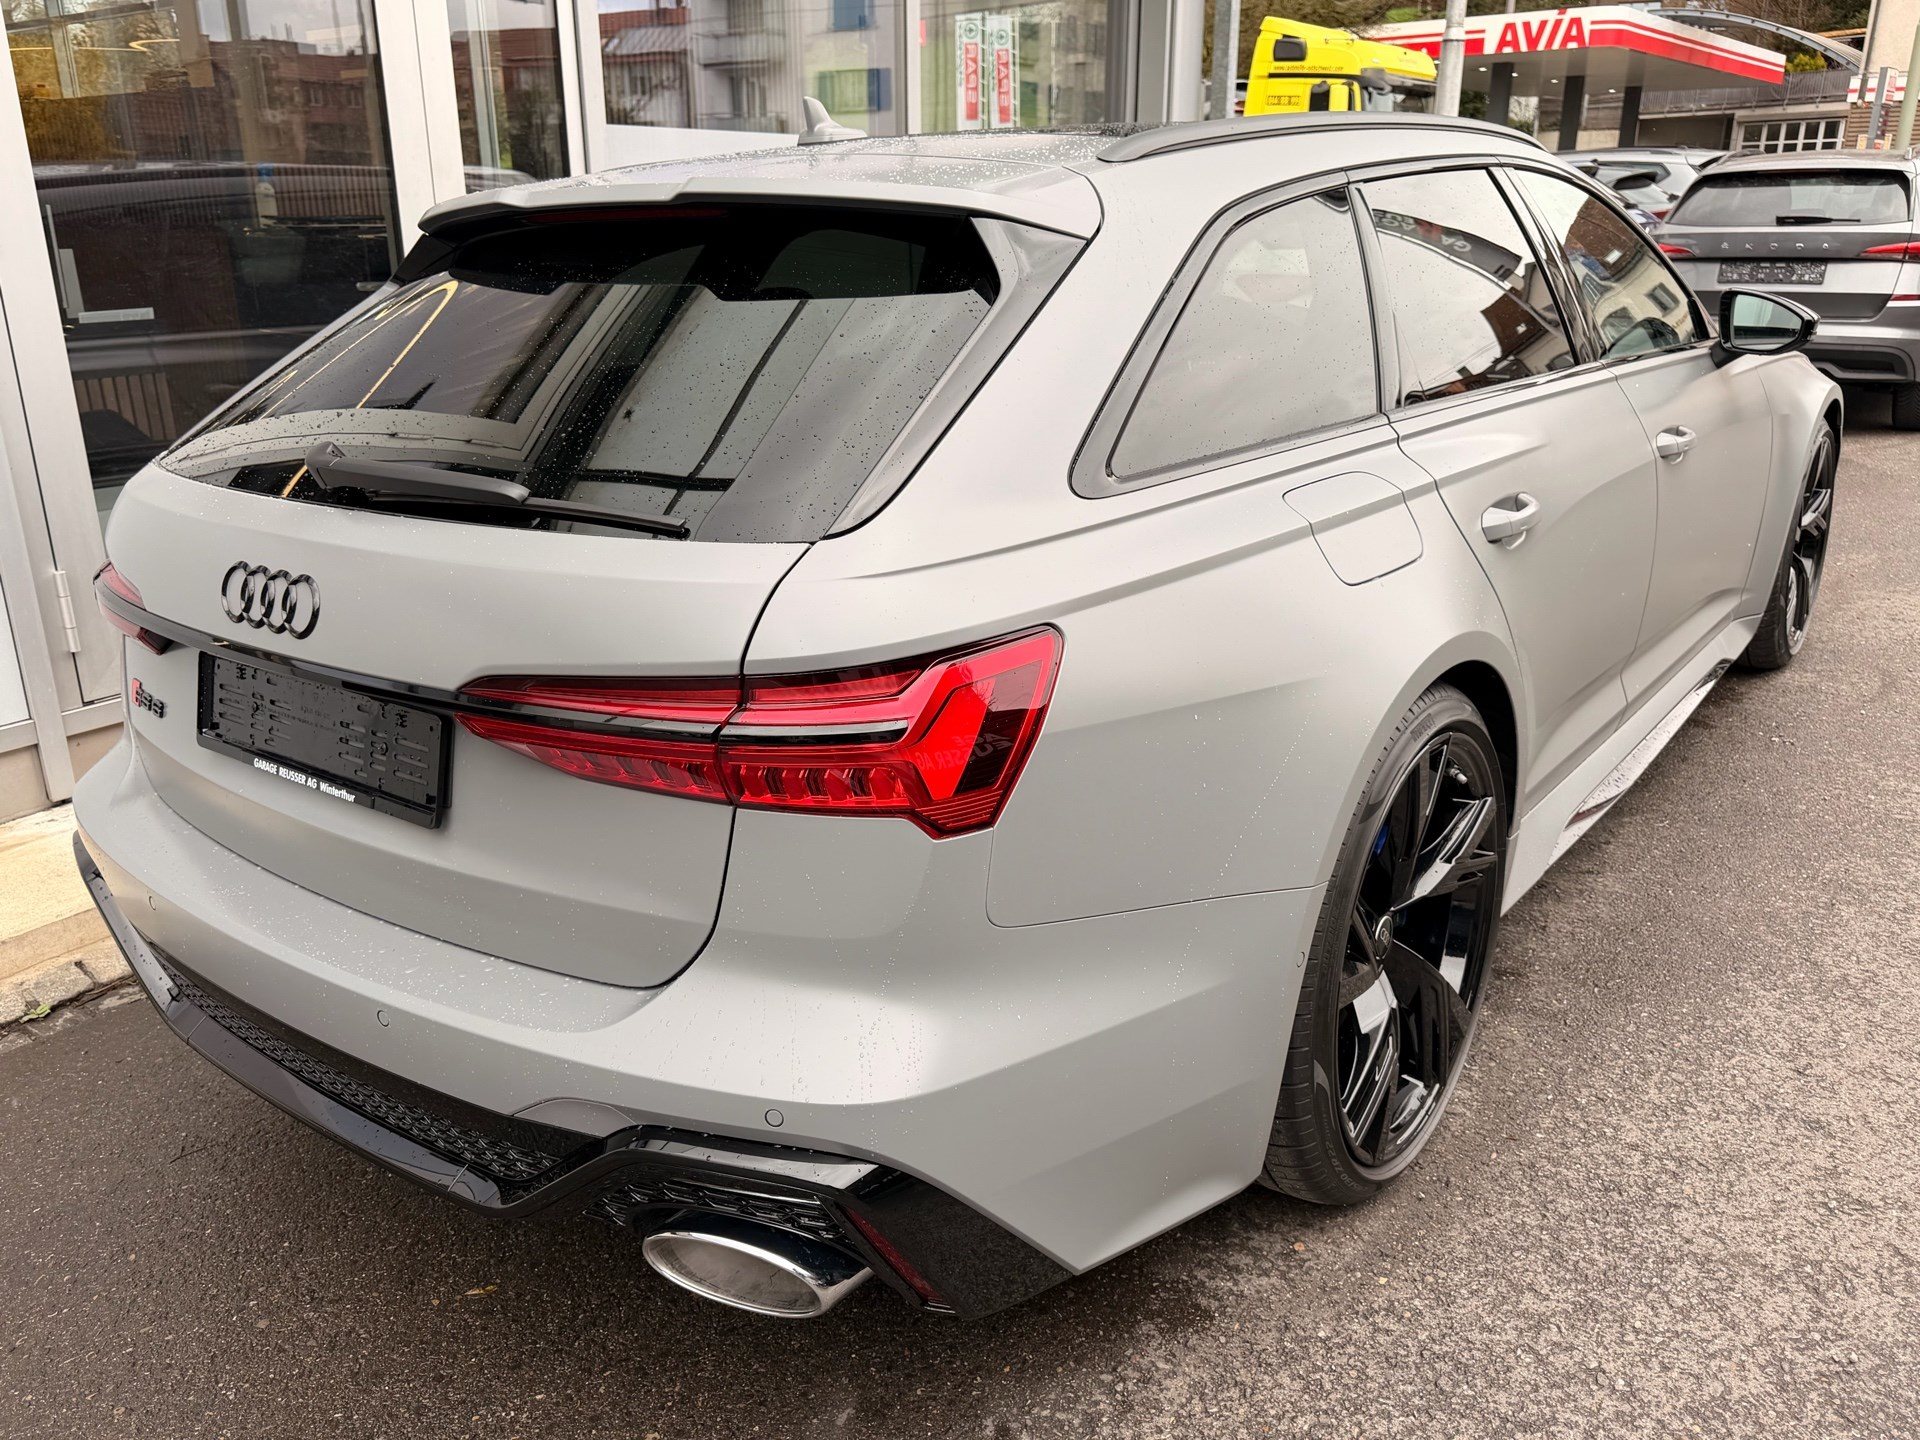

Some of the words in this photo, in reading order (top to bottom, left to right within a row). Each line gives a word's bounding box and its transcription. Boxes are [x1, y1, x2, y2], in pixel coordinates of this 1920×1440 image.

[1494, 8, 1586, 54] AVIA
[254, 758, 277, 775] GARAGE
[279, 766, 306, 786] REUSSER
[307, 777, 317, 789] AG
[319, 781, 356, 802] Winterthur
